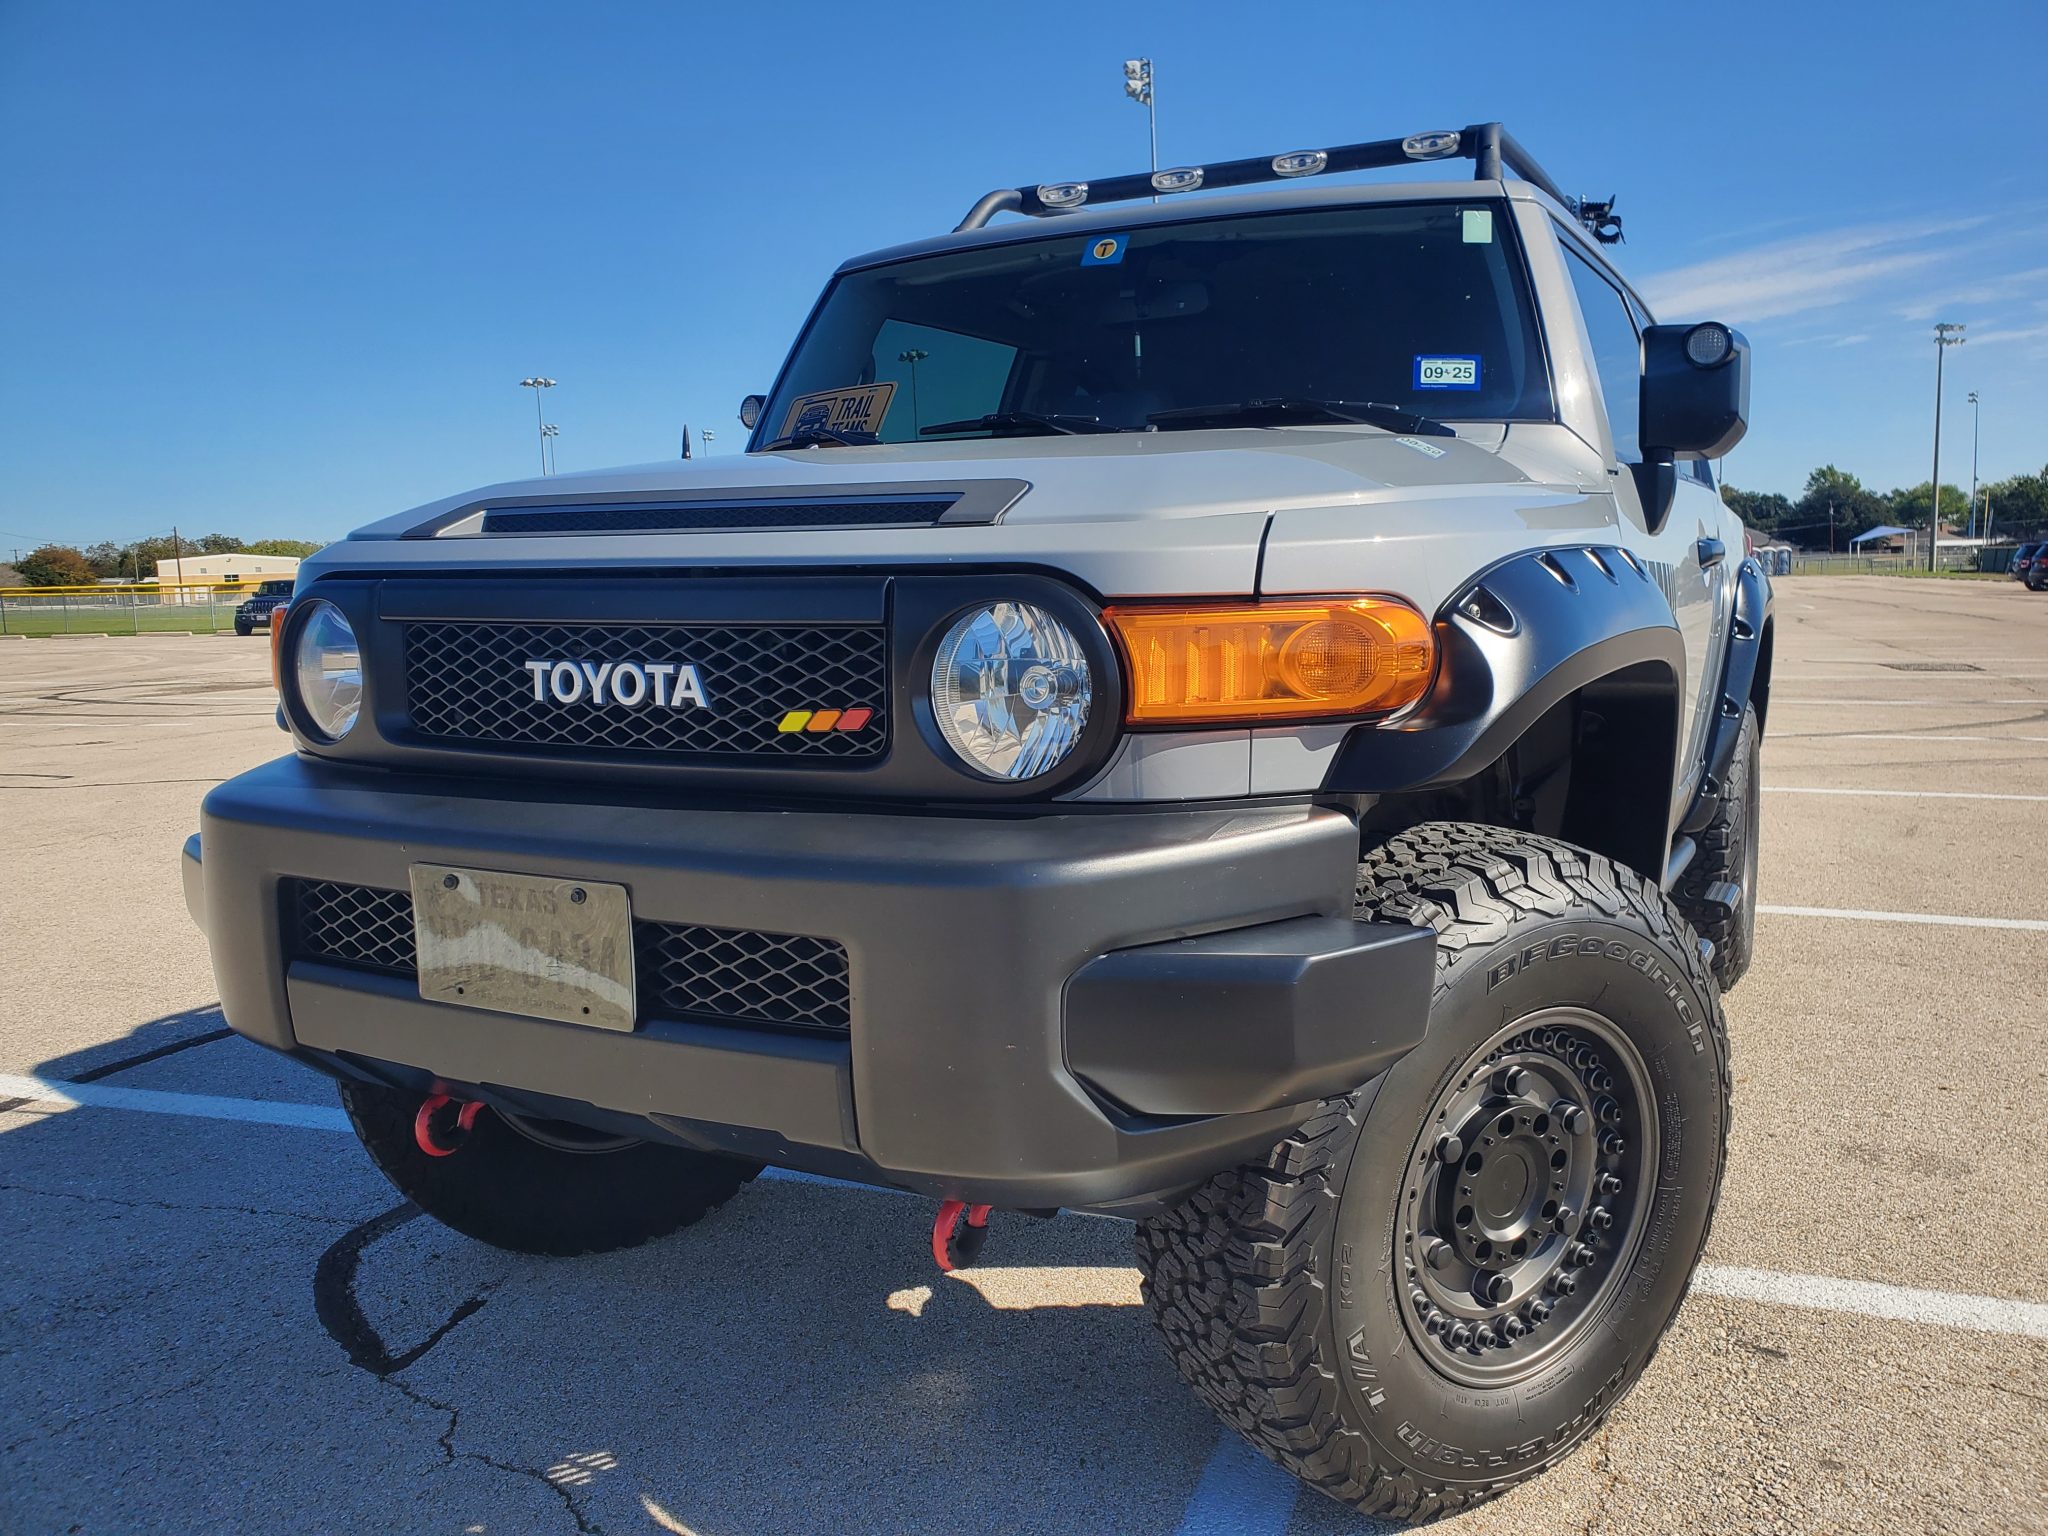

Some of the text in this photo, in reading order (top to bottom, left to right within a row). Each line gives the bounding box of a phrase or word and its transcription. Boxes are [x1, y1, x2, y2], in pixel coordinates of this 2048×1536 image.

[1099, 242, 1115, 258] T
[1424, 367, 1472, 379] 09 25
[835, 394, 875, 421] TRAIL
[525, 660, 709, 709] TOYOTA
[478, 882, 559, 914] TEXAS
[1486, 934, 1705, 1055] BFGoodrich
[1346, 1324, 1387, 1416] T/A
